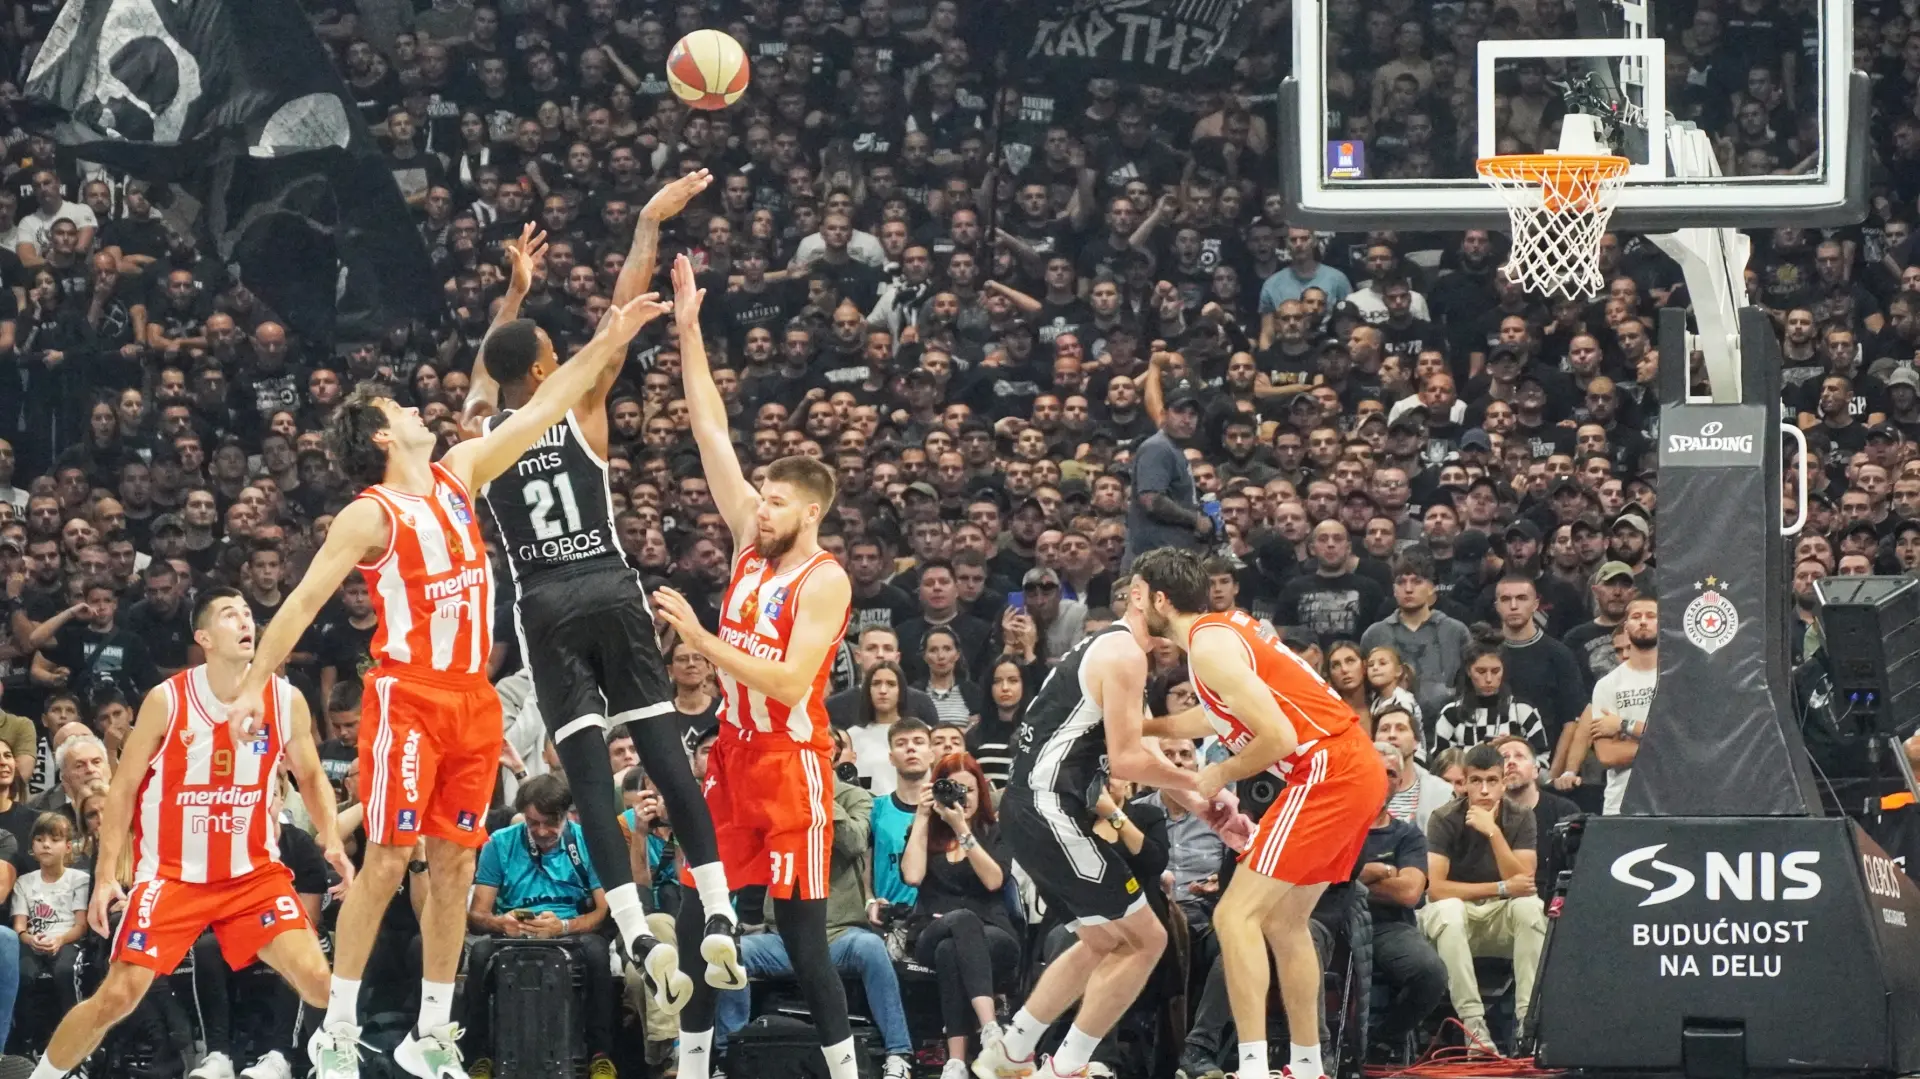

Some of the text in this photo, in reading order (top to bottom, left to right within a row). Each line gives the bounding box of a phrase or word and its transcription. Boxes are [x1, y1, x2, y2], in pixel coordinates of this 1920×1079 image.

[1669, 434, 1753, 453] SPALDING
[518, 451, 562, 476] mts
[522, 471, 582, 540] 21
[519, 529, 602, 561] GLOBOS
[213, 749, 232, 776] 9
[401, 728, 421, 803] carnex
[176, 786, 262, 806] meridian
[192, 812, 247, 834] mts
[568, 843, 581, 866] EOS
[769, 852, 795, 885] 31
[1706, 851, 1822, 901] NIS
[275, 896, 300, 921] 9
[1633, 917, 1809, 946] BUDUĆNOST
[1660, 955, 1782, 977] NA DELU
